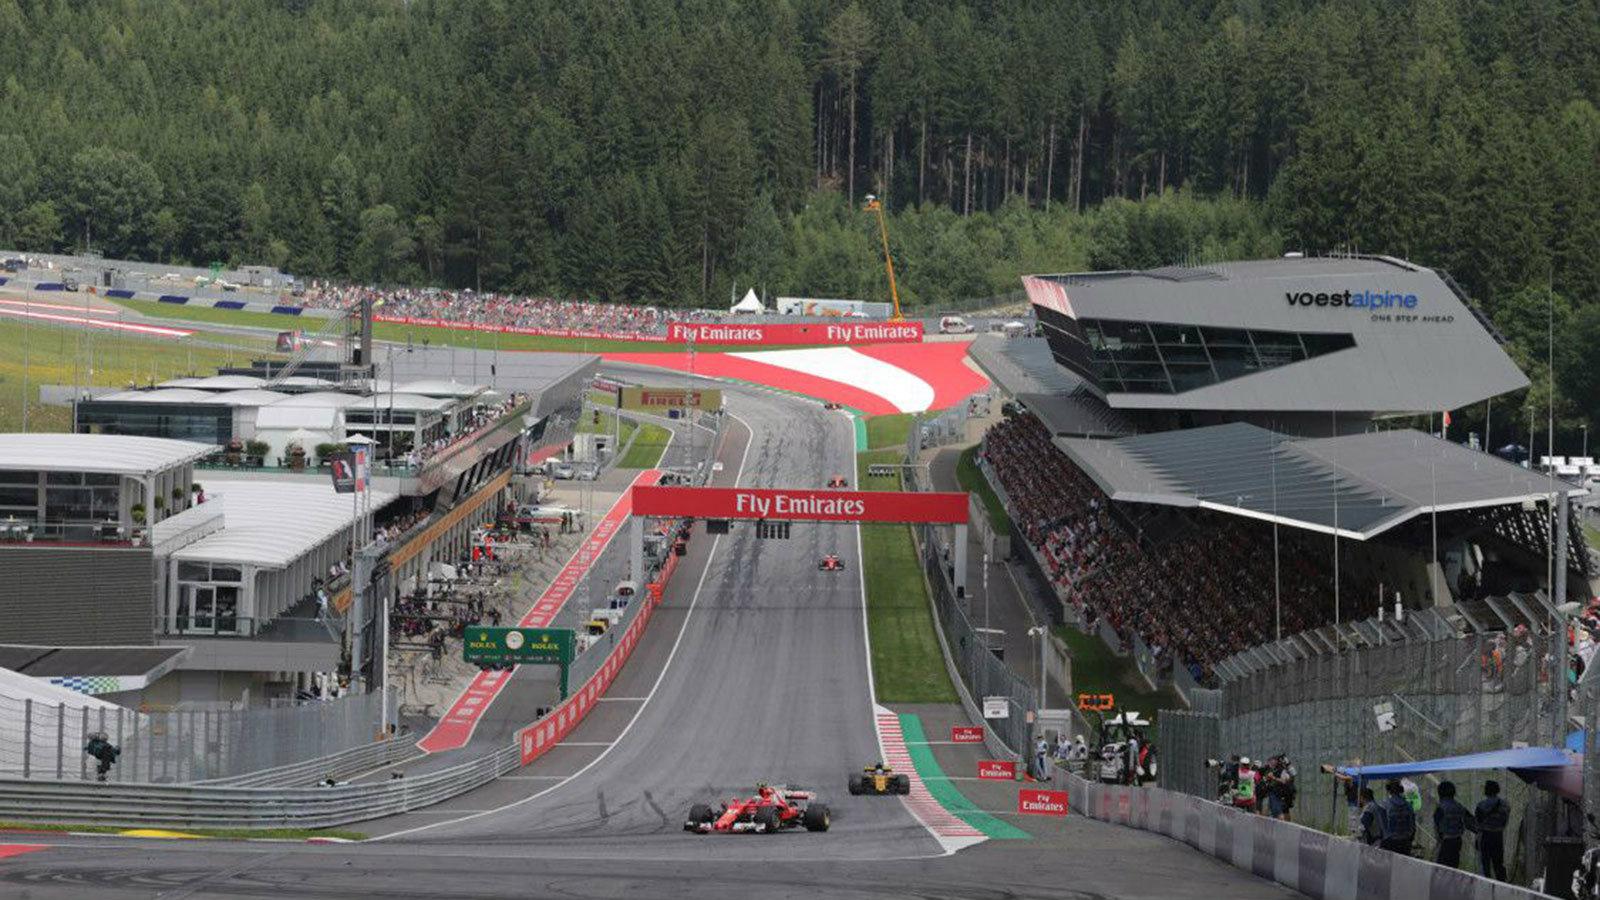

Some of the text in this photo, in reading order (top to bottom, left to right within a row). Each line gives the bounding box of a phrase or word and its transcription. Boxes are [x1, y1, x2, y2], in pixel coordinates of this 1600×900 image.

[1286, 290, 1418, 310] voestalpine
[1371, 314, 1391, 322] ONE
[1422, 315, 1454, 323] AHEAD
[673, 325, 763, 341] Fly Emirates
[827, 325, 918, 341] Fly Emirates
[736, 493, 865, 516] Fly Emirates
[1023, 801, 1064, 811] Emirates
